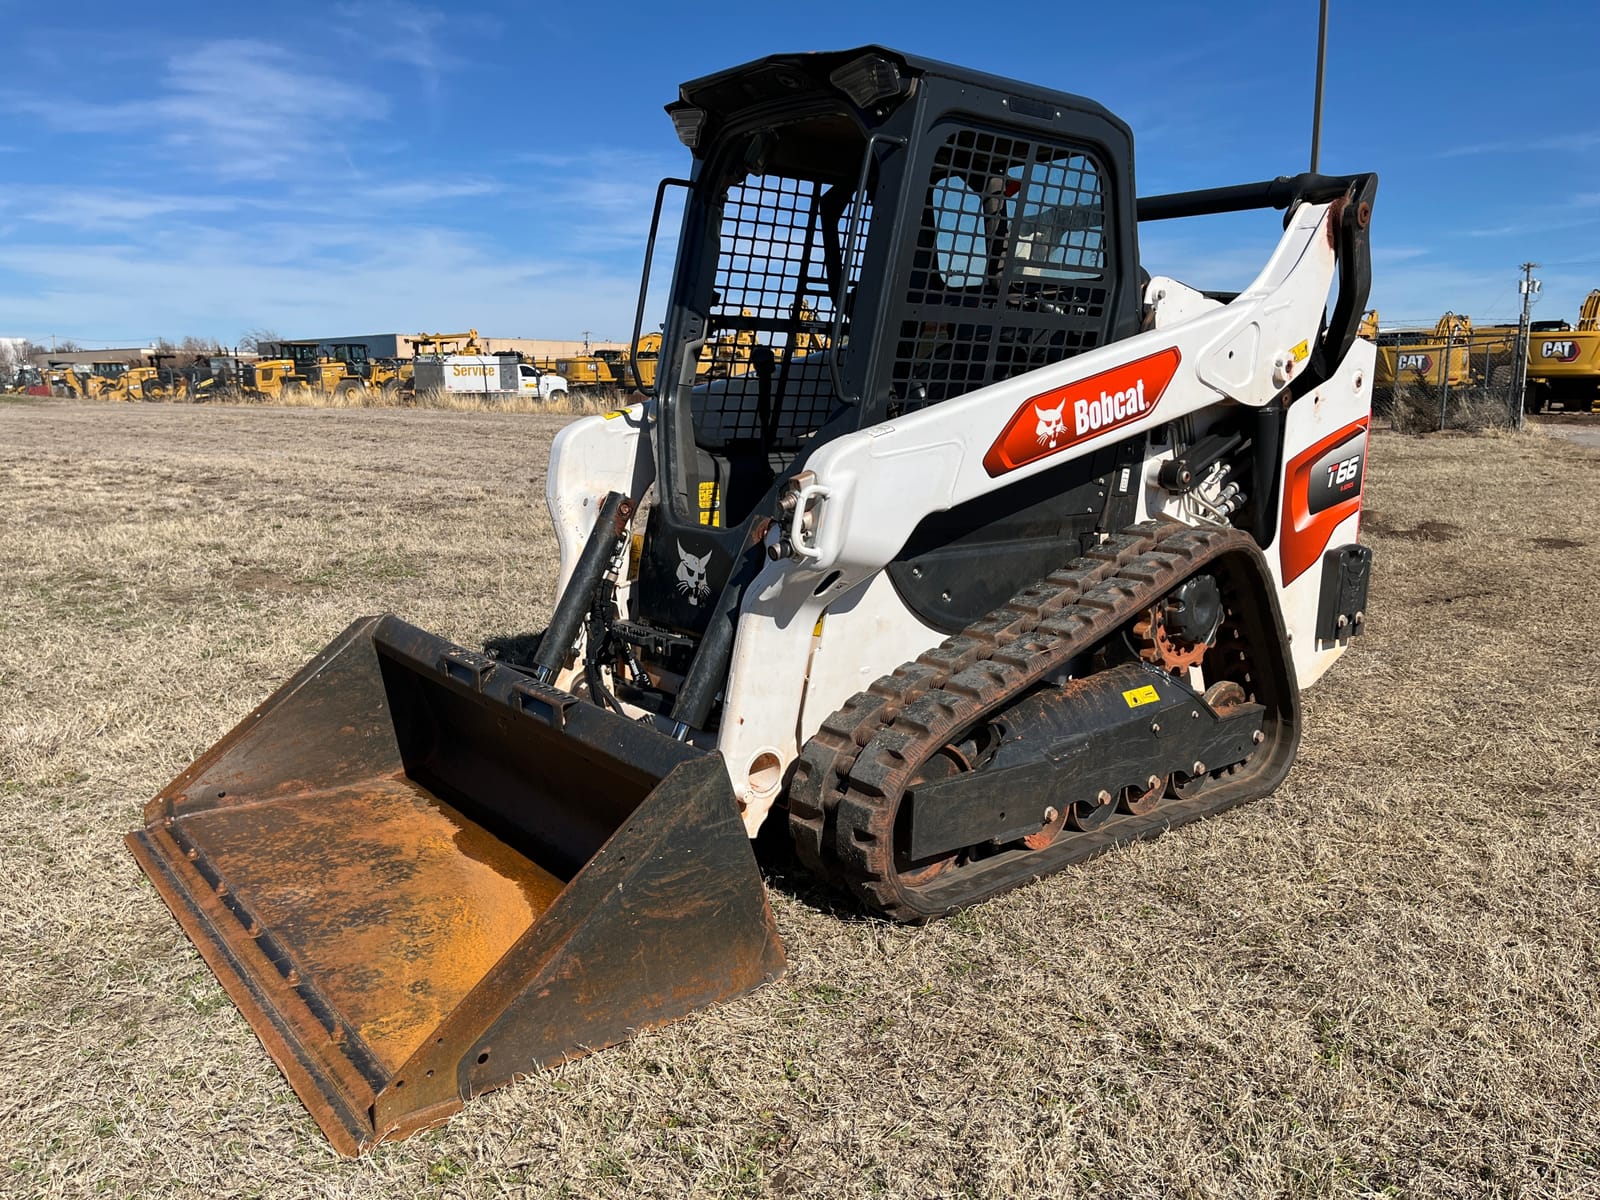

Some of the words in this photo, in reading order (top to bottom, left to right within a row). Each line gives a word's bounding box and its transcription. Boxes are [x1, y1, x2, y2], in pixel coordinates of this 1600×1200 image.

[1542, 341, 1572, 358] CAT
[453, 363, 495, 376] Service
[1398, 354, 1426, 370] CAT
[1074, 378, 1146, 436] Bobcat
[1327, 455, 1360, 488] T66
